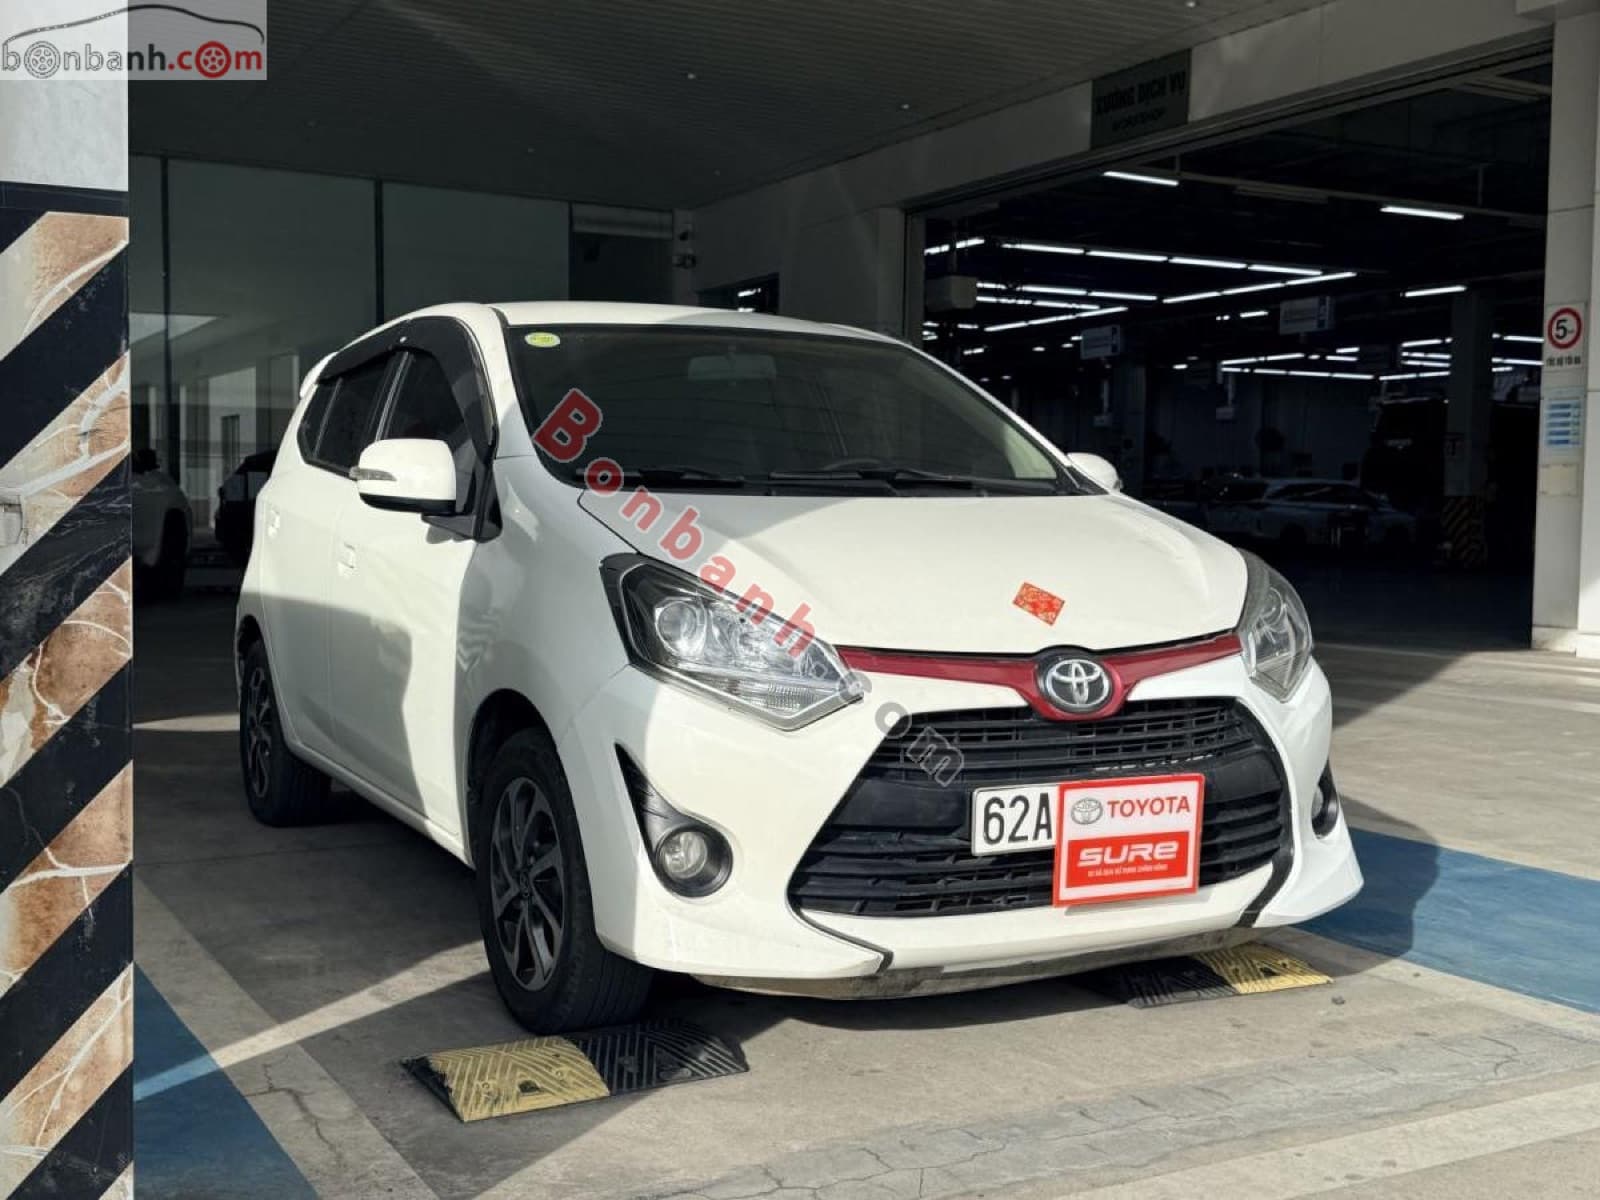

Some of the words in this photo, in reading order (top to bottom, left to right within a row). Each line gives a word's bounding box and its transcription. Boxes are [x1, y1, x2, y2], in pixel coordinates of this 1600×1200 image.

[1555, 319, 1568, 340] 5
[983, 792, 1053, 846] 62A
[1107, 796, 1191, 819] TOYOTA
